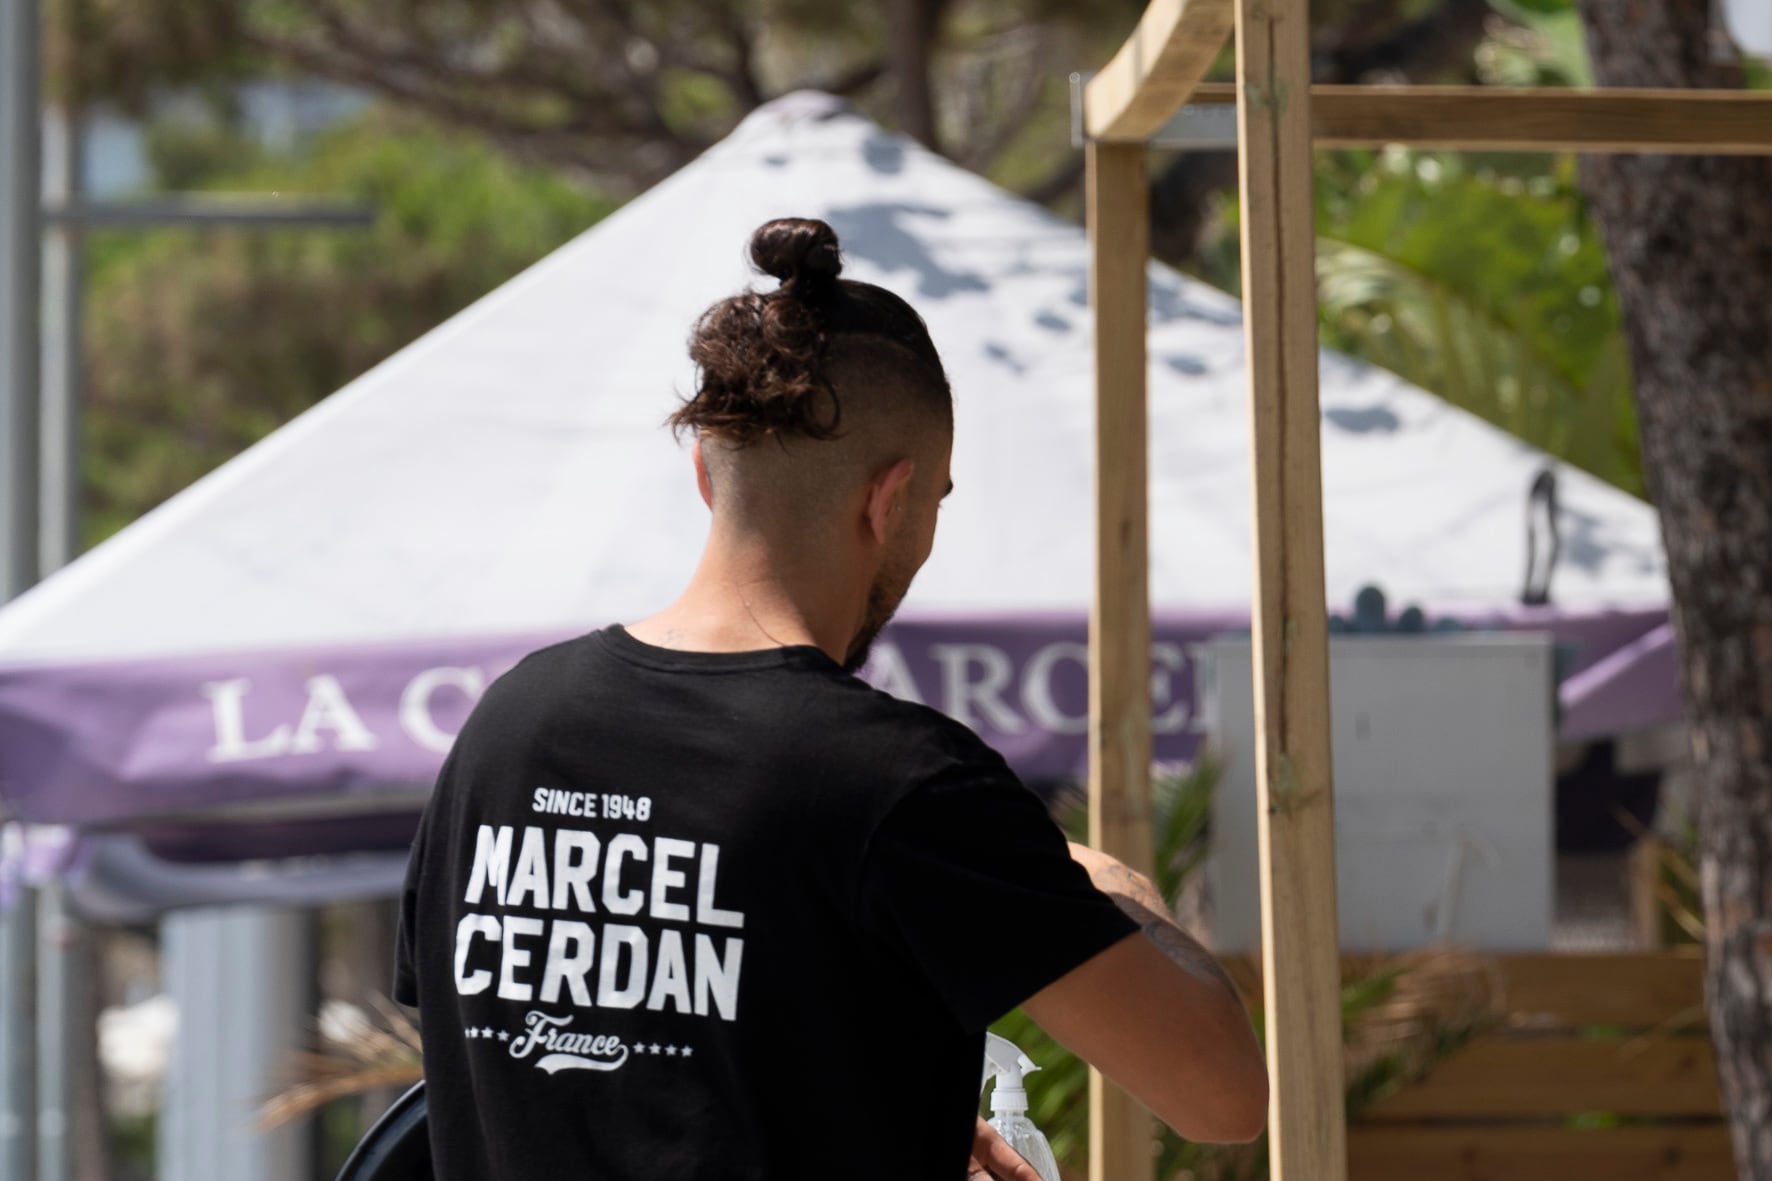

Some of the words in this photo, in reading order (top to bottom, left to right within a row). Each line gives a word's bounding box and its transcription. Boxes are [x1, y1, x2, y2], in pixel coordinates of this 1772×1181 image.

[204, 672, 378, 764] LA
[532, 787, 597, 818] SINCE
[601, 793, 652, 821] 1948
[464, 824, 745, 928] MARCEL
[454, 913, 744, 1021] CERDAN
[508, 1009, 629, 1075] France
